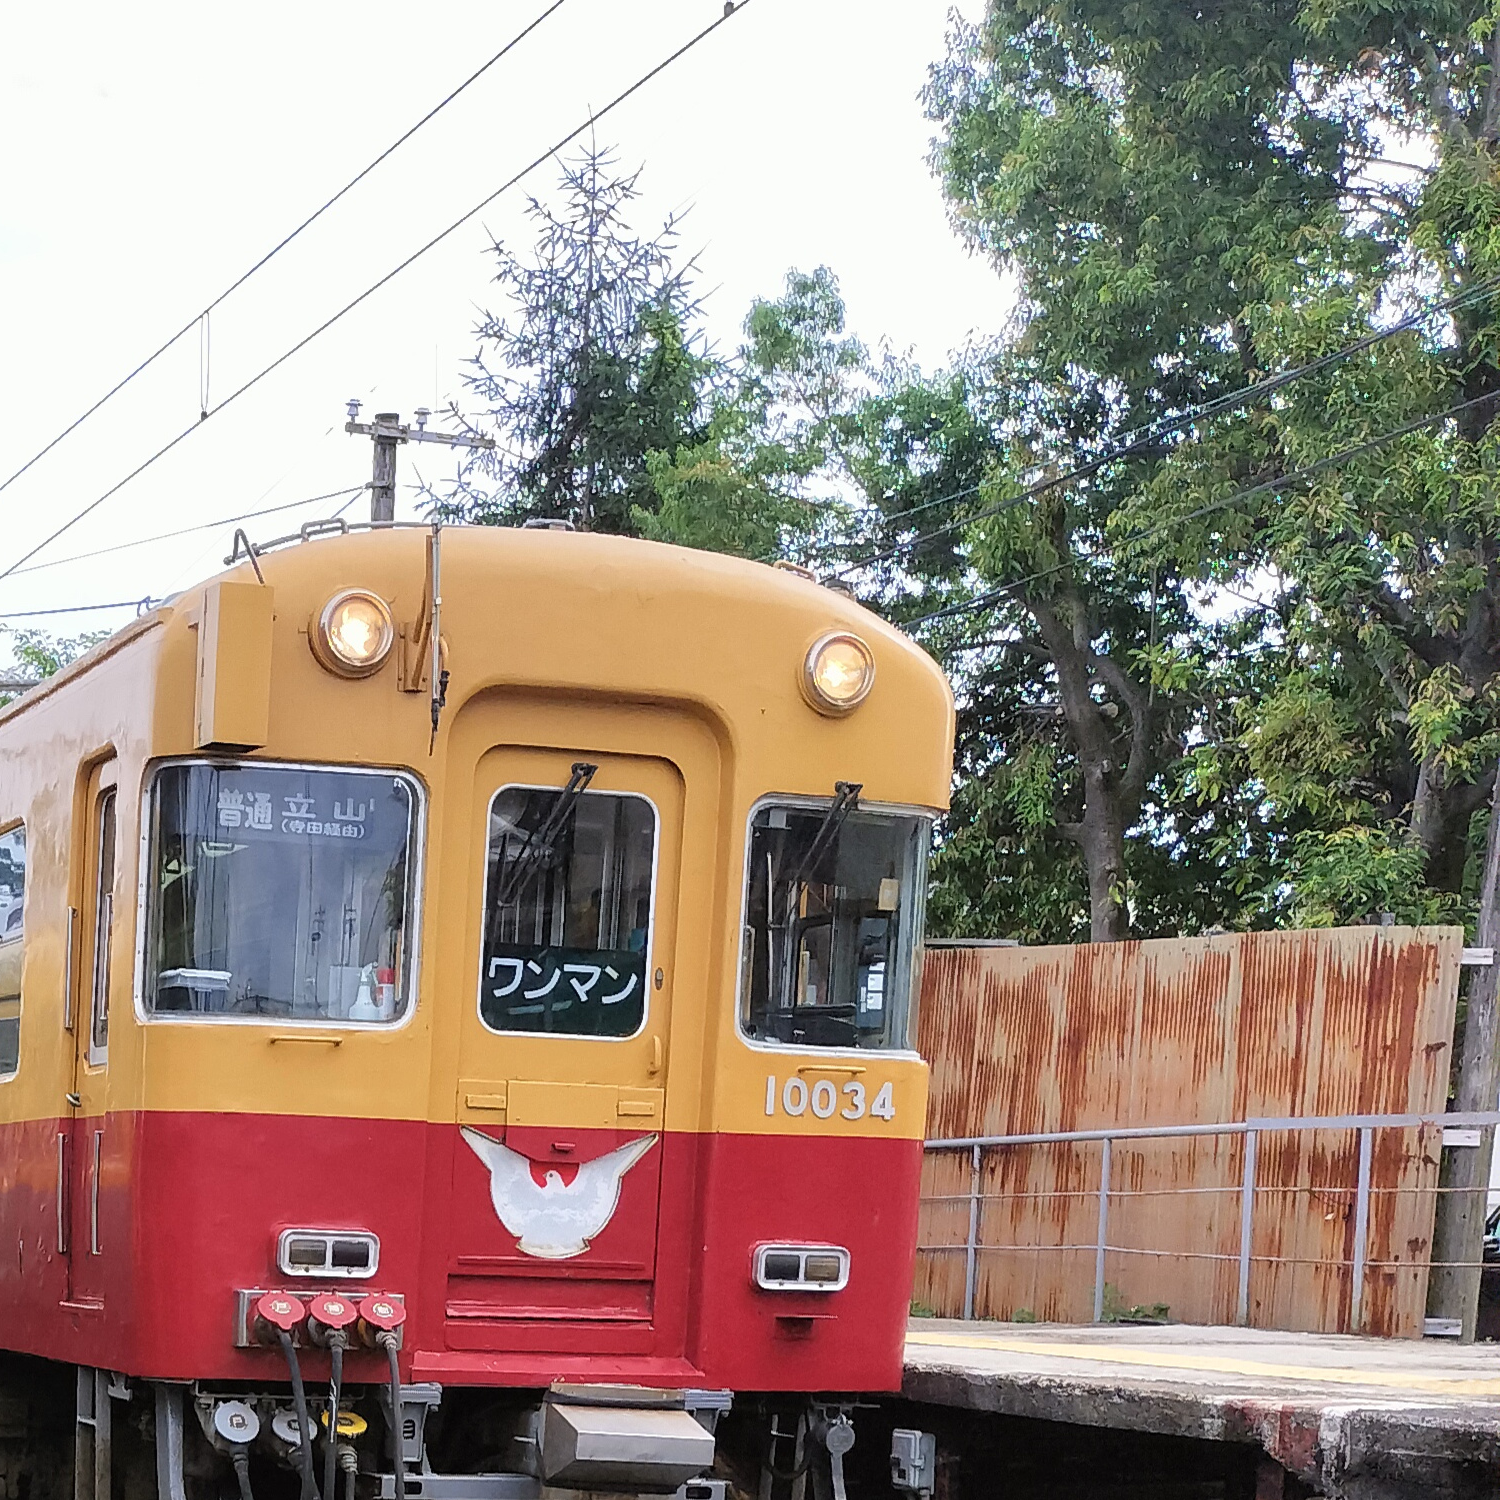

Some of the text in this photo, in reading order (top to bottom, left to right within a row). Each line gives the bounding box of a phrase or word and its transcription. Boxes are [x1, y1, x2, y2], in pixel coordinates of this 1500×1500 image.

[217, 788, 273, 831] 普通
[488, 956, 638, 1005] ワンマン
[764, 1075, 896, 1121] 10034
